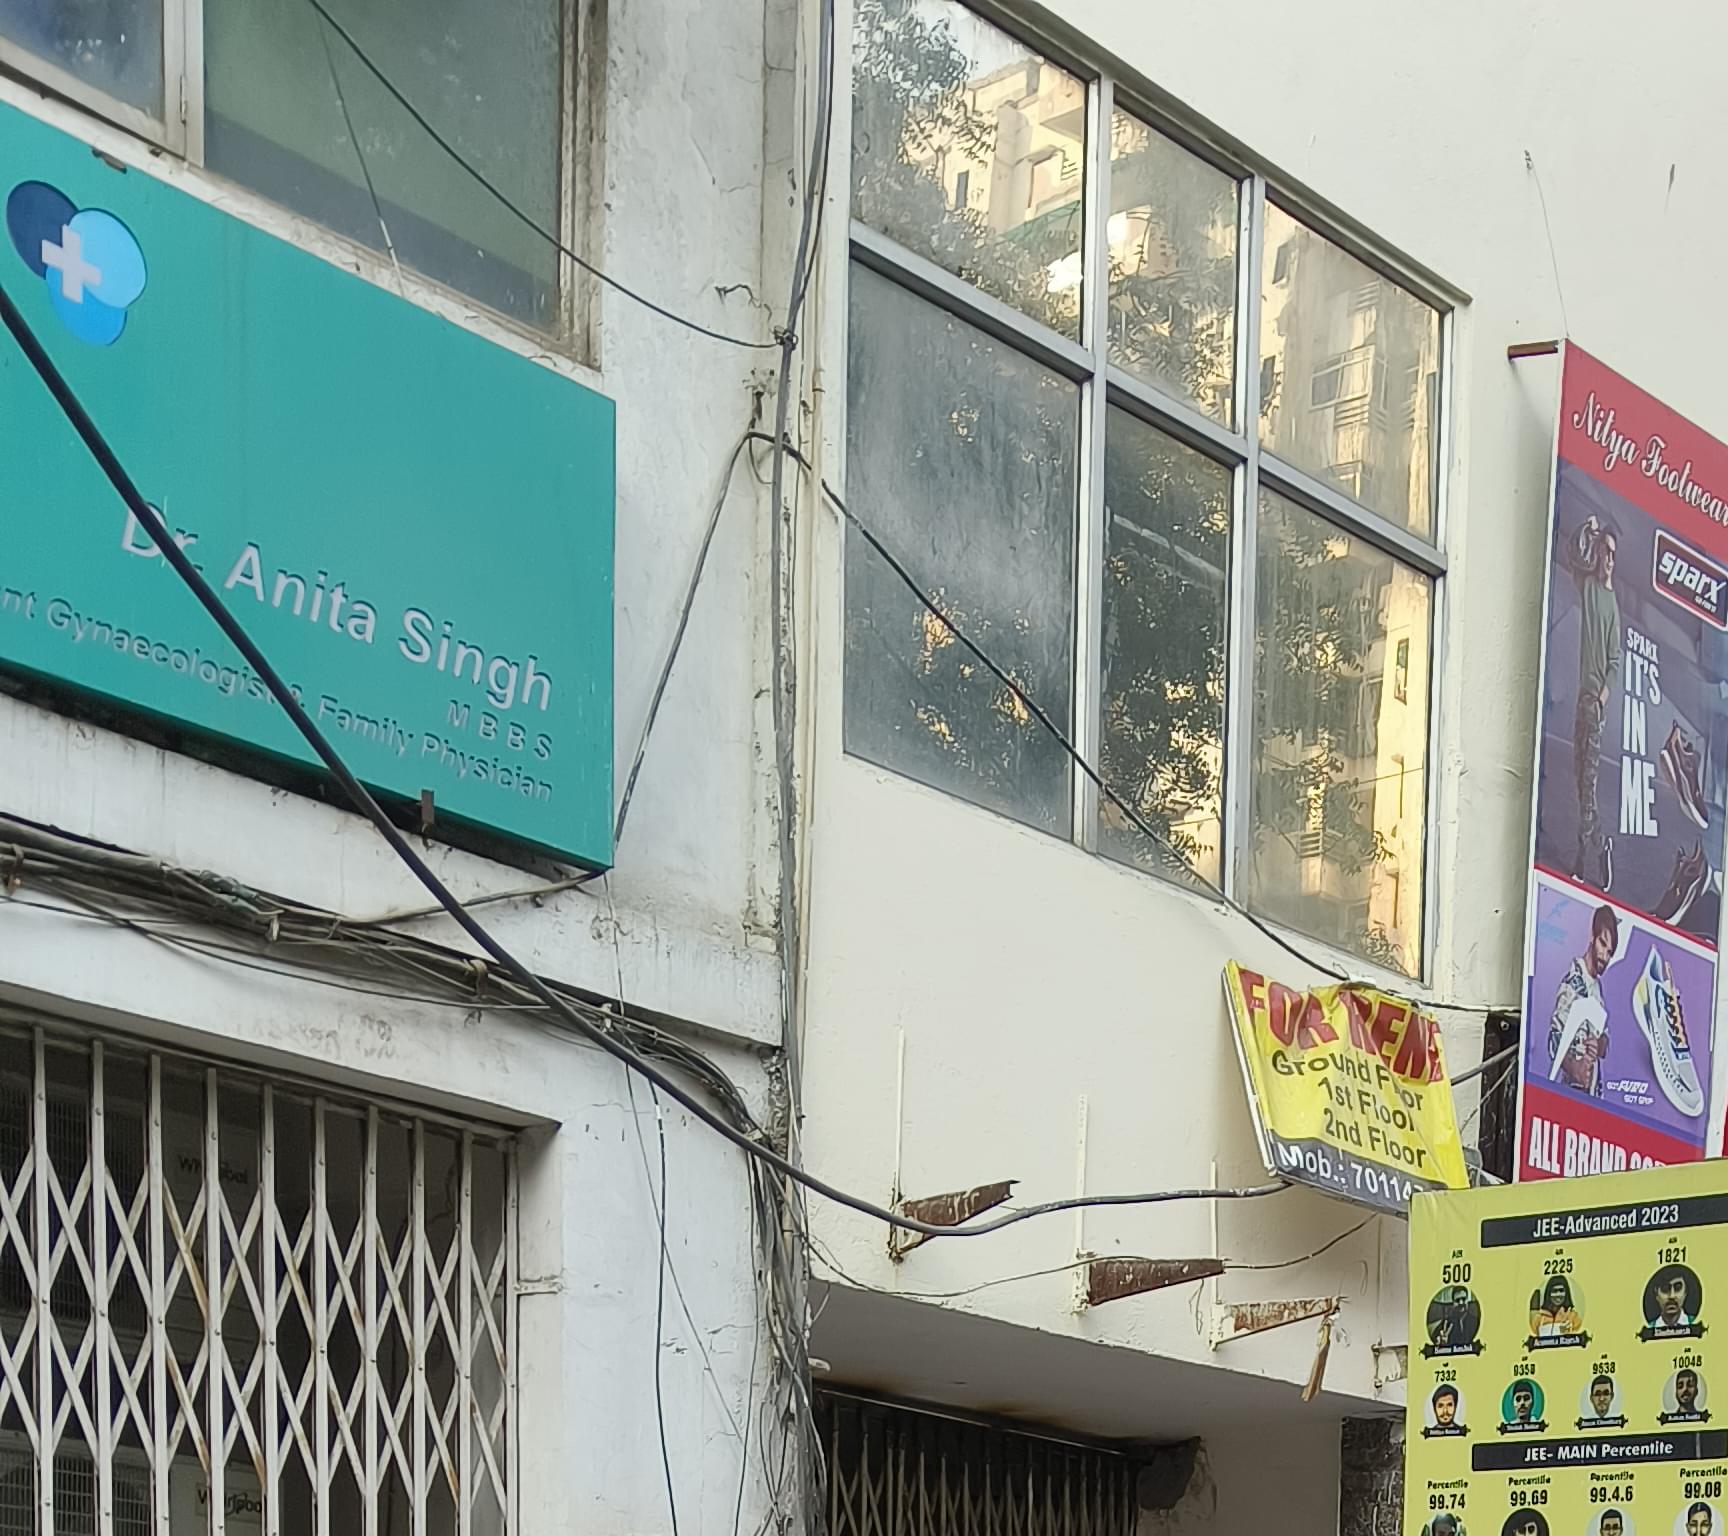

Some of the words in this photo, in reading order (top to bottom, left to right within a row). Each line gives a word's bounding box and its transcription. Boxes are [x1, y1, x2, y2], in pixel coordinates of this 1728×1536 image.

[1573, 391, 1640, 472] Nitya
[1658, 551, 1727, 604] sparx
[223, 541, 377, 645] Anita
[398, 607, 552, 711] Singh
[1625, 650, 1661, 705] IT'S
[317, 694, 414, 757] Family
[421, 732, 552, 802] Physician
[447, 700, 470, 729] M
[479, 712, 498, 741] B
[507, 721, 526, 751] B
[534, 733, 552, 760] S
[1622, 694, 1646, 757] IN
[1620, 755, 1659, 838] ME
[1238, 968, 1340, 1050] FOR
[1339, 991, 1445, 1082] RENT
[1271, 1049, 1371, 1084] Ground
[1317, 1076, 1353, 1111] 1st
[1358, 1088, 1416, 1132] Floor
[1323, 1108, 1362, 1147] 2nd
[1368, 1125, 1427, 1169] Floor
[1528, 1115, 1561, 1177] ALL
[1350, 1162, 1424, 1201] 70114
[1532, 1208, 1637, 1238] JEE-Advanced
[1641, 1204, 1679, 1226] 2023
[1441, 1262, 1472, 1285] 500
[1543, 1258, 1573, 1276] 2225
[1657, 1246, 1687, 1265] 1821
[1524, 1446, 1554, 1463] JEE-
[1557, 1443, 1598, 1461] MAIN
[1428, 1494, 1466, 1511] 99.74
